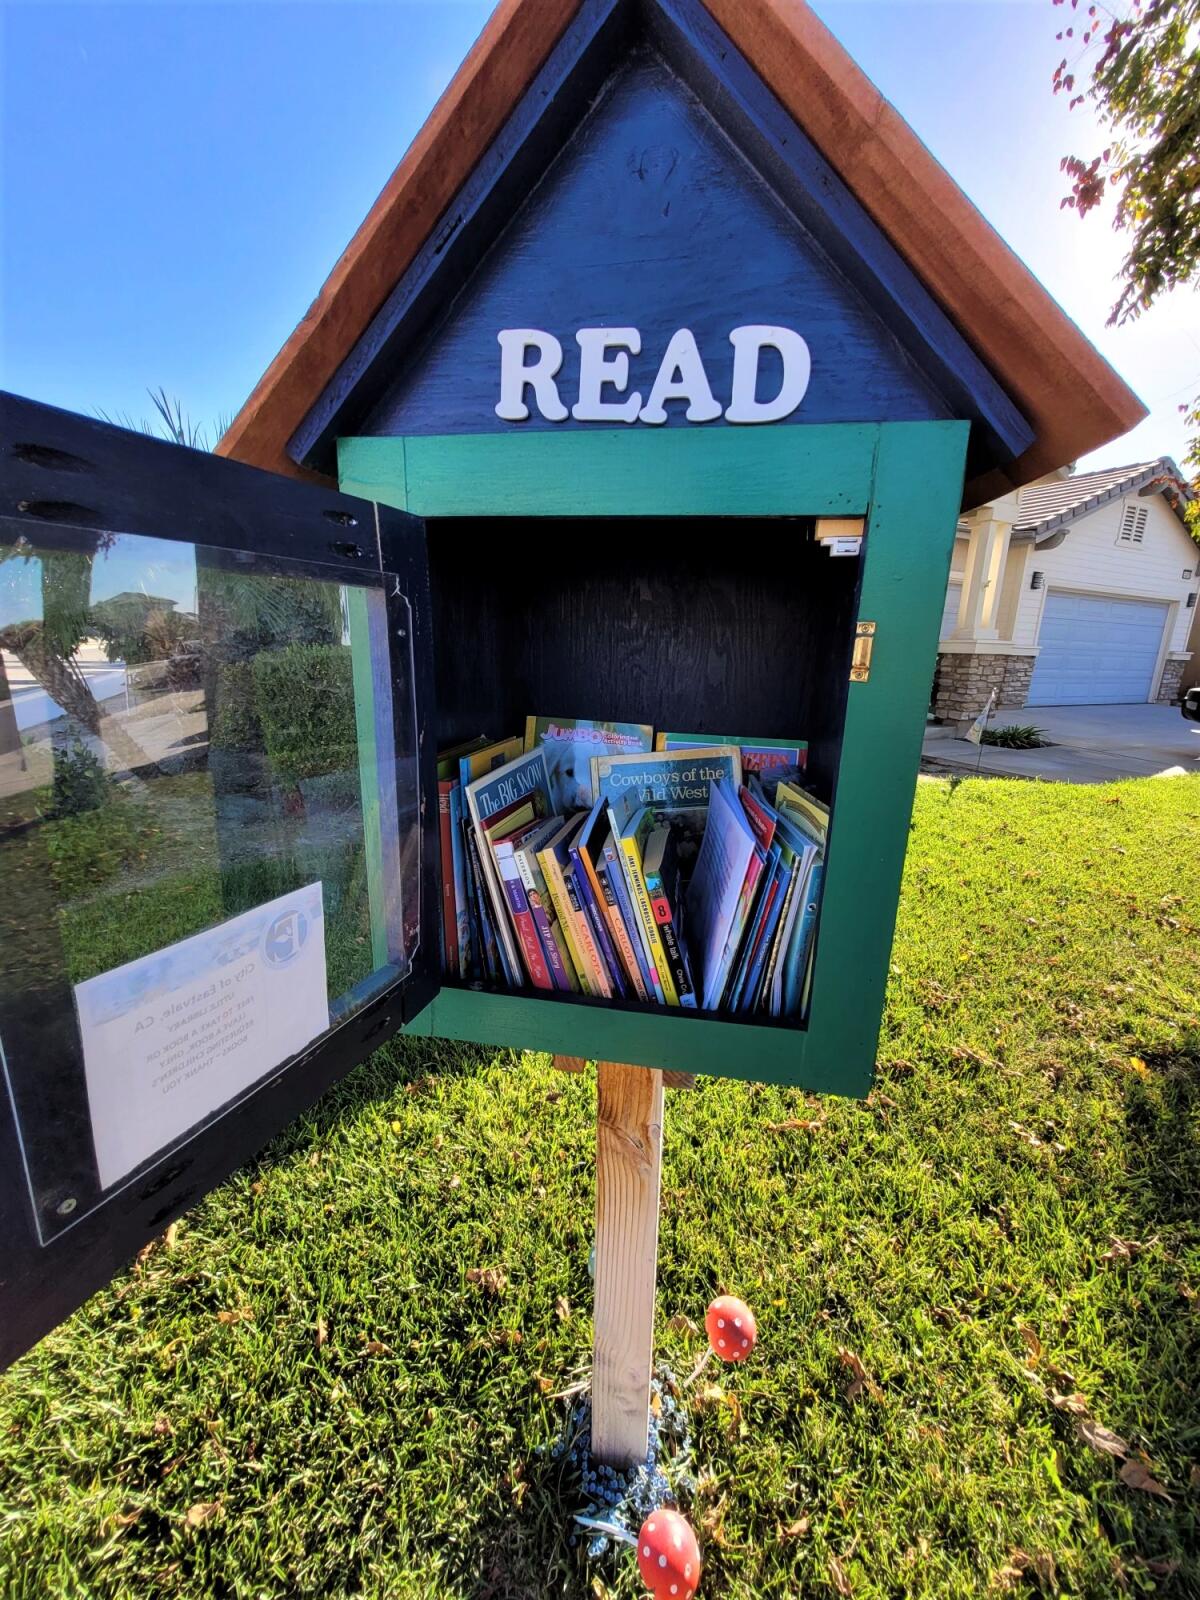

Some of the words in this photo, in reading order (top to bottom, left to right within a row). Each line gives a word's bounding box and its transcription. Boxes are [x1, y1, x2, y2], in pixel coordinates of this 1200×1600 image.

[495, 325, 811, 424] READ
[541, 724, 601, 744] JUMBO
[480, 792, 501, 816] The
[500, 778, 519, 805] BIG
[515, 761, 542, 793] SNOW
[610, 771, 680, 787] Cowboys
[682, 768, 697, 781] of
[700, 767, 725, 780] the
[670, 786, 708, 799] West
[516, 853, 531, 885] PATERSON
[626, 854, 637, 869] JAKE
[637, 896, 654, 926] LACROSSE
[646, 925, 658, 945] GOALIE
[577, 923, 603, 976] CARLOTA
[612, 916, 636, 966] CARLOTA
[661, 924, 675, 945] whale
[668, 946, 680, 960] talk
[674, 968, 686, 984] Chris
